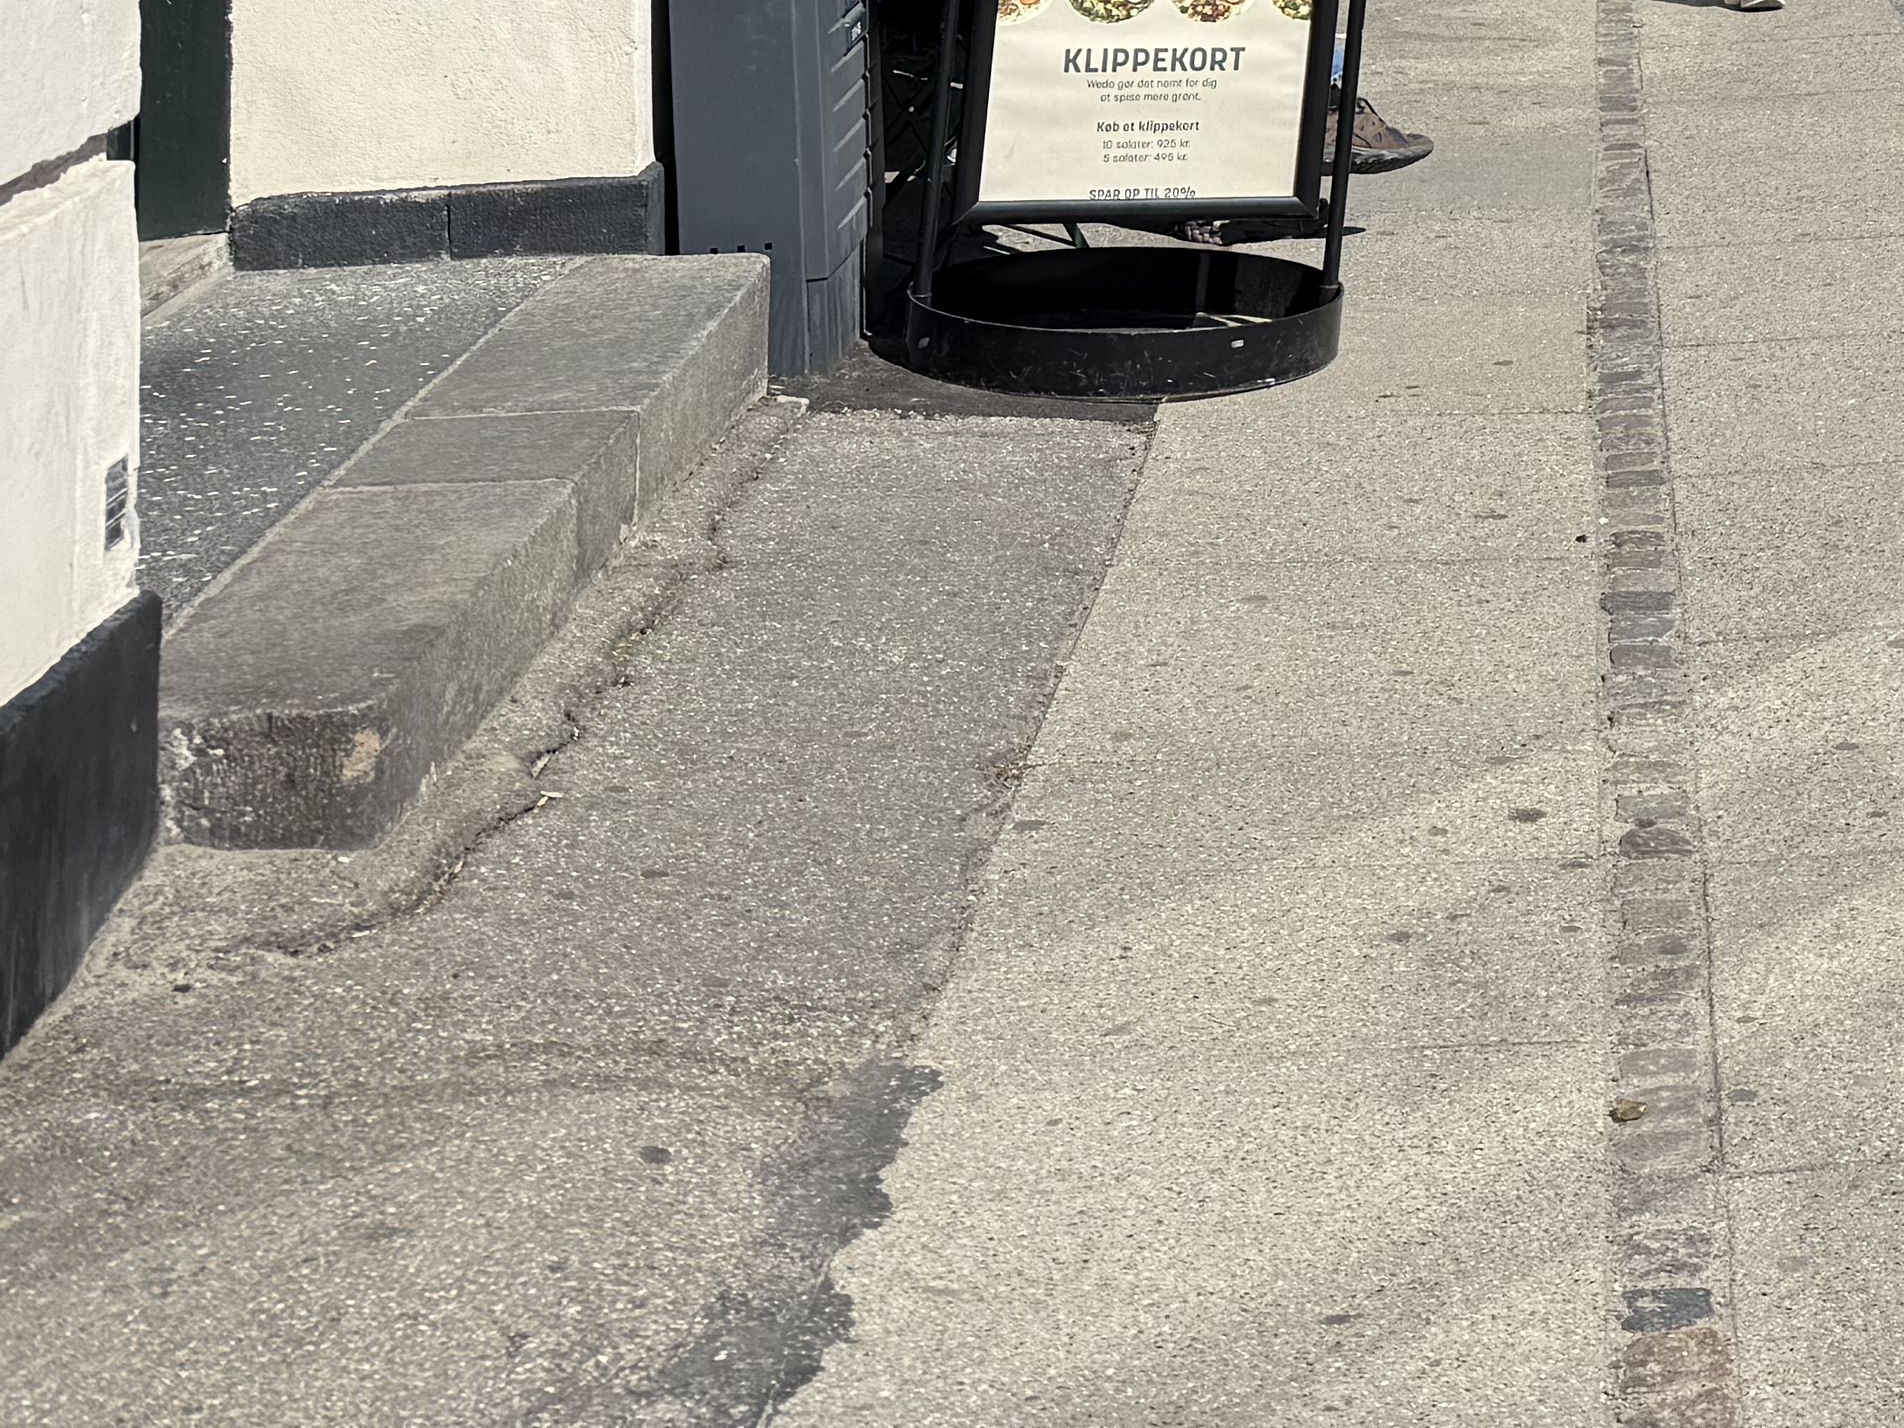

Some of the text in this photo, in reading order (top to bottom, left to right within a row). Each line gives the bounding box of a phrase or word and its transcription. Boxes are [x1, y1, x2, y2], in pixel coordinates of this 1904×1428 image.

[1063, 47, 1246, 74] KLIPPEKORT
[1186, 78, 1200, 88] for
[1202, 78, 1218, 89] dig
[1114, 93, 1141, 104] spise
[1144, 94, 1169, 102] mere
[1097, 121, 1120, 133] Køb
[1138, 121, 1200, 134] klippekort
[1102, 140, 1113, 150] 10
[1103, 154, 1110, 163] 5
[1089, 186, 1196, 201] SPAR OP TIL 20%
